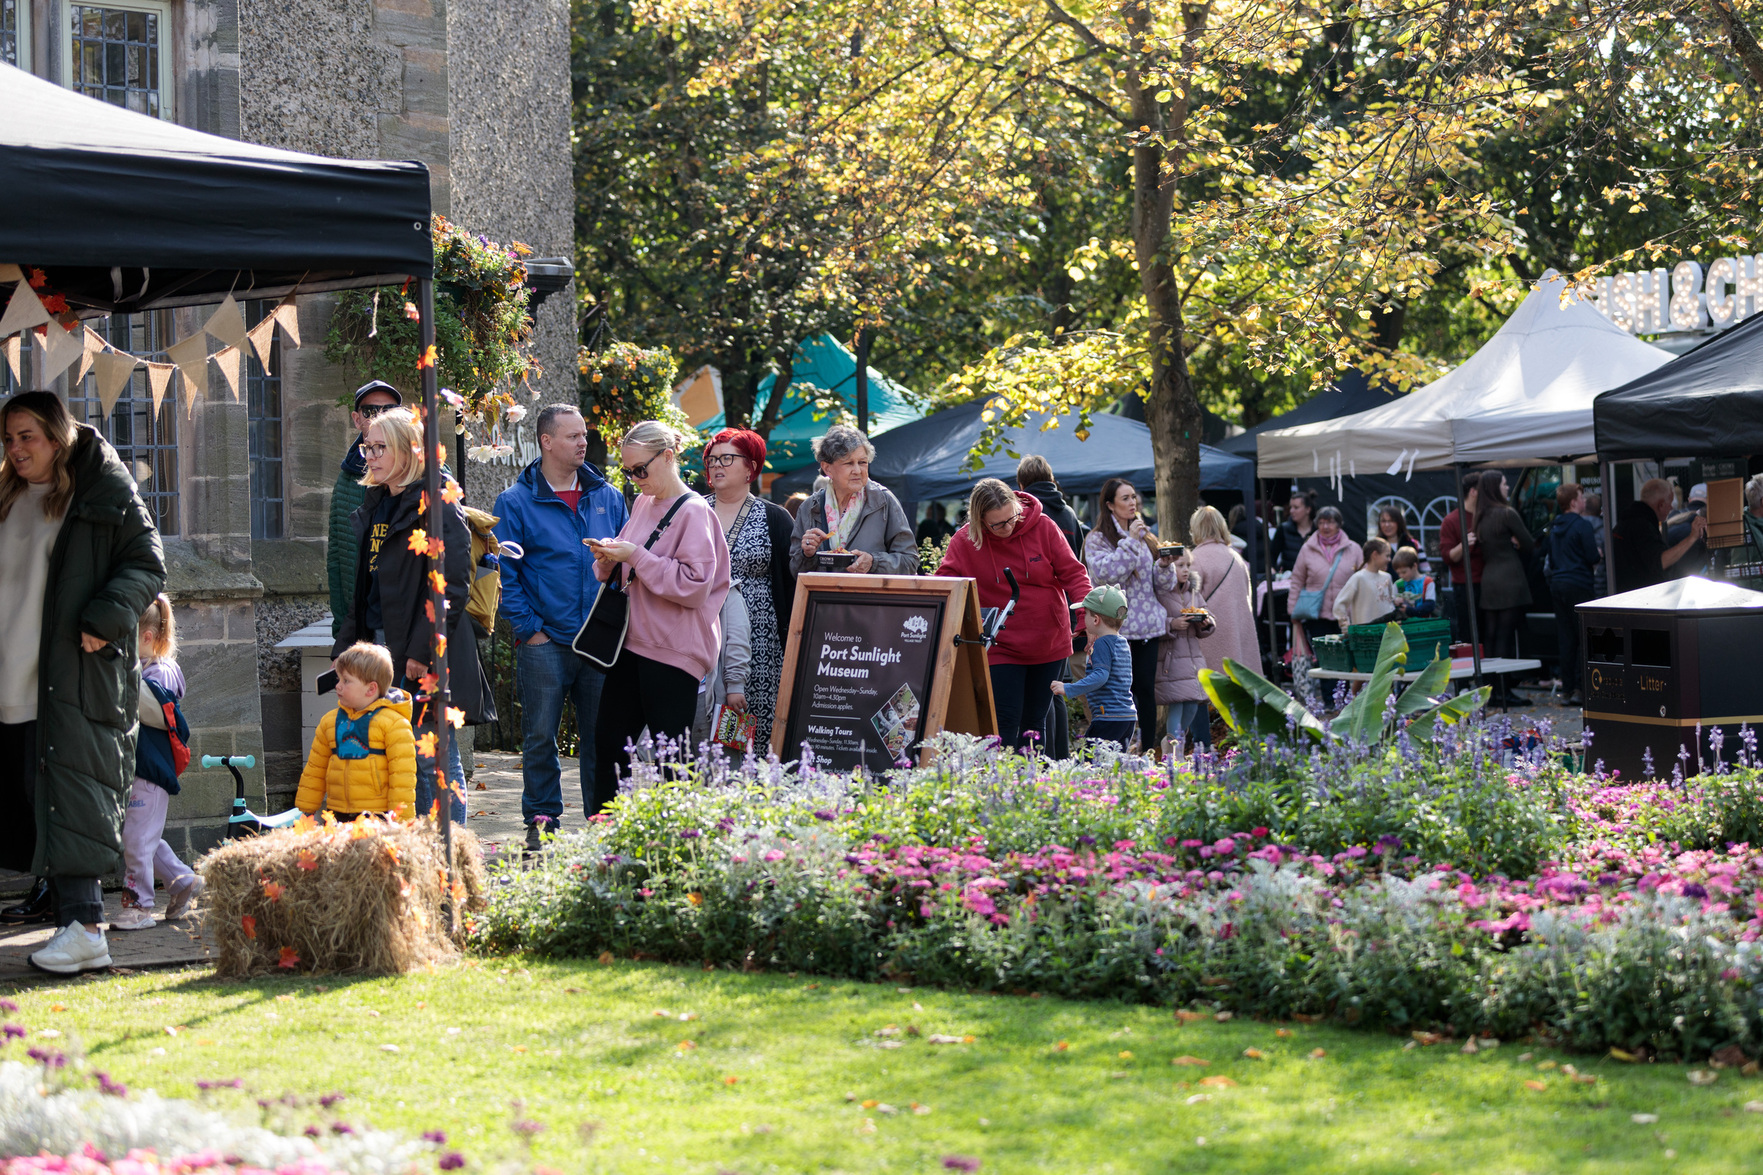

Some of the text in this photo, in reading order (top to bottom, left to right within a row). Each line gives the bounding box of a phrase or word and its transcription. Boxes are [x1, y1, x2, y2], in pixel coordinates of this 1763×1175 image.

[369, 538, 384, 553] N
[824, 631, 862, 643] Welcome to
[820, 644, 901, 667] Port Sunlight
[817, 661, 869, 679] Museum
[814, 684, 829, 693] Open
[1640, 675, 1664, 691] Litter
[811, 701, 853, 711] Admission applies.
[725, 710, 738, 743] MONKEY
[808, 725, 853, 736] Walking Tours
[816, 755, 832, 765] Shop
